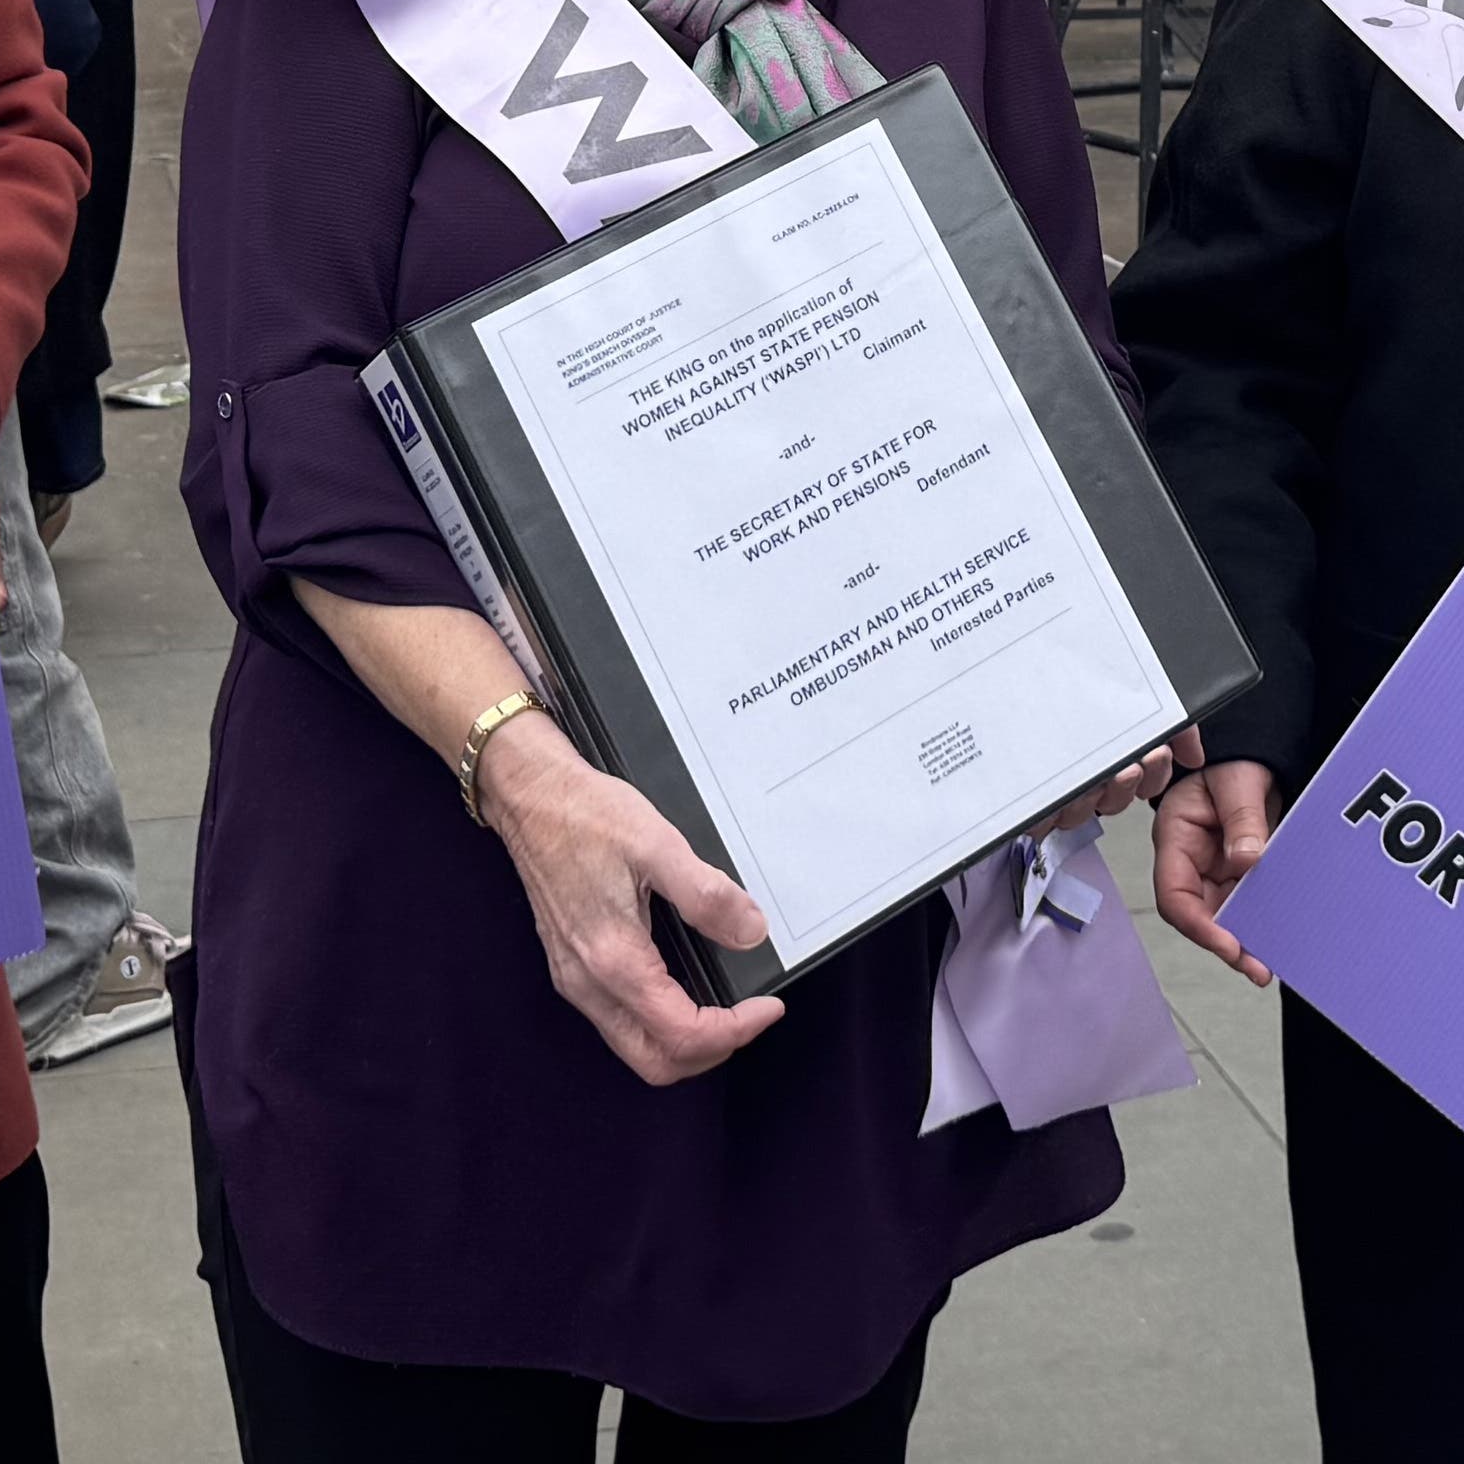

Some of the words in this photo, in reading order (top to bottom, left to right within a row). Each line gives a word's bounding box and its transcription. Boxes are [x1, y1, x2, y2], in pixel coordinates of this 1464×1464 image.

[620, 392, 687, 437] WOMEN
[688, 353, 757, 403] AGAINST
[758, 325, 812, 363] STATE
[810, 288, 880, 336] PENSION
[626, 378, 664, 406] THE
[663, 357, 705, 388] KING
[707, 347, 729, 366] on
[728, 333, 755, 354] the
[756, 290, 837, 339] application
[837, 275, 854, 296] of
[663, 380, 757, 443] INEQUALITY
[829, 326, 862, 352] LTD
[861, 317, 928, 360] Claimant
[692, 533, 729, 562] THE
[728, 478, 823, 543] SECRETARY
[826, 465, 848, 488] OF
[849, 436, 903, 475] STATE
[901, 417, 938, 446] FOR
[777, 432, 816, 460] -and-
[915, 441, 991, 493] Defendant
[741, 523, 796, 563] WORK
[797, 504, 831, 535] AND
[830, 459, 911, 514] PENSIONS
[727, 623, 861, 715] PARLIAMENTARY
[865, 604, 899, 636] AND
[898, 566, 963, 613] HEALTH
[962, 526, 1031, 575] SERVICE
[842, 561, 881, 589] -and-
[928, 598, 1004, 652] Interested
[1002, 570, 1055, 608] Parties
[789, 635, 894, 707] OMBUDSMAN
[895, 614, 929, 646] AND
[930, 576, 994, 623] OTHERS
